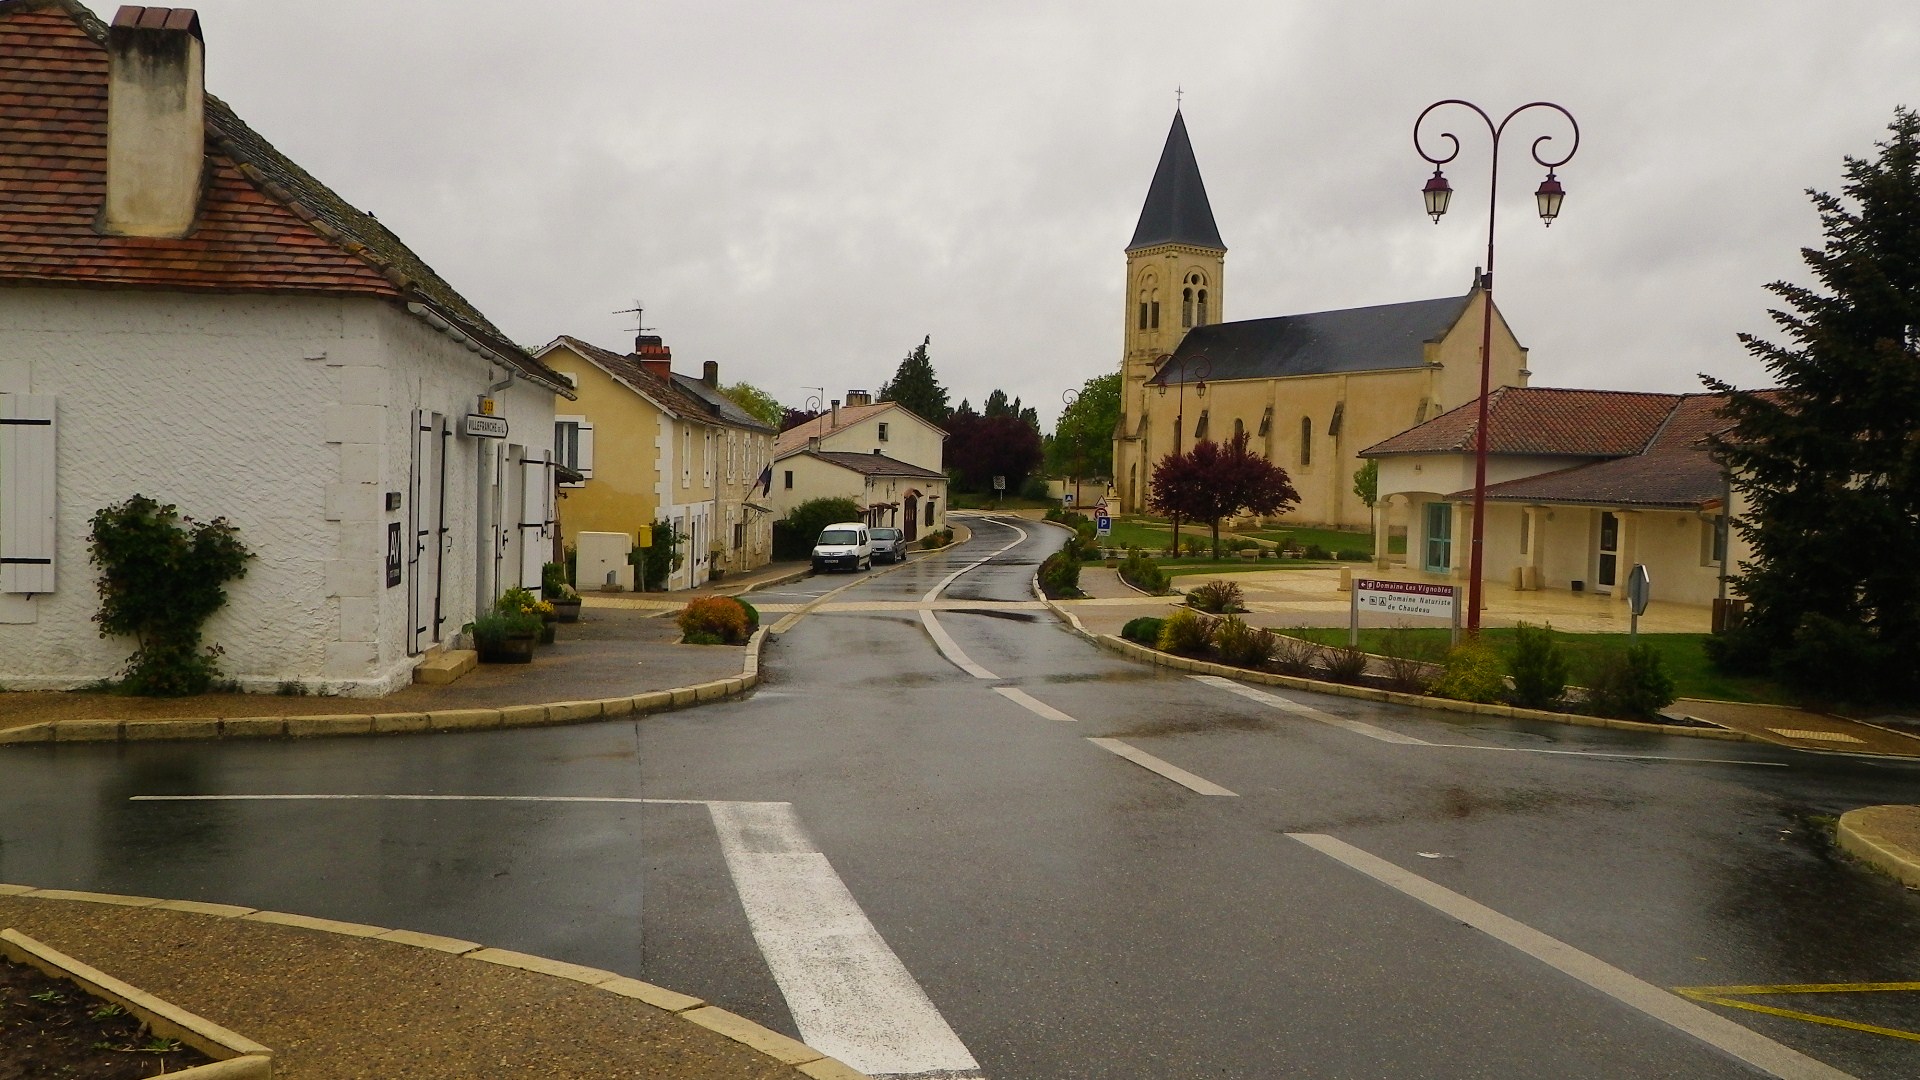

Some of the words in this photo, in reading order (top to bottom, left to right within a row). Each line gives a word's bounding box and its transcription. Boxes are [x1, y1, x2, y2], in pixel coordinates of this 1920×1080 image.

[1101, 519, 1107, 528] P
[1376, 581, 1403, 590] Domaine
[1405, 583, 1416, 591] Les
[1418, 584, 1451, 594] Vignobles
[1388, 595, 1416, 603] Domaine
[1419, 597, 1451, 606] Naturiste
[1398, 604, 1430, 613] Chaudeau
